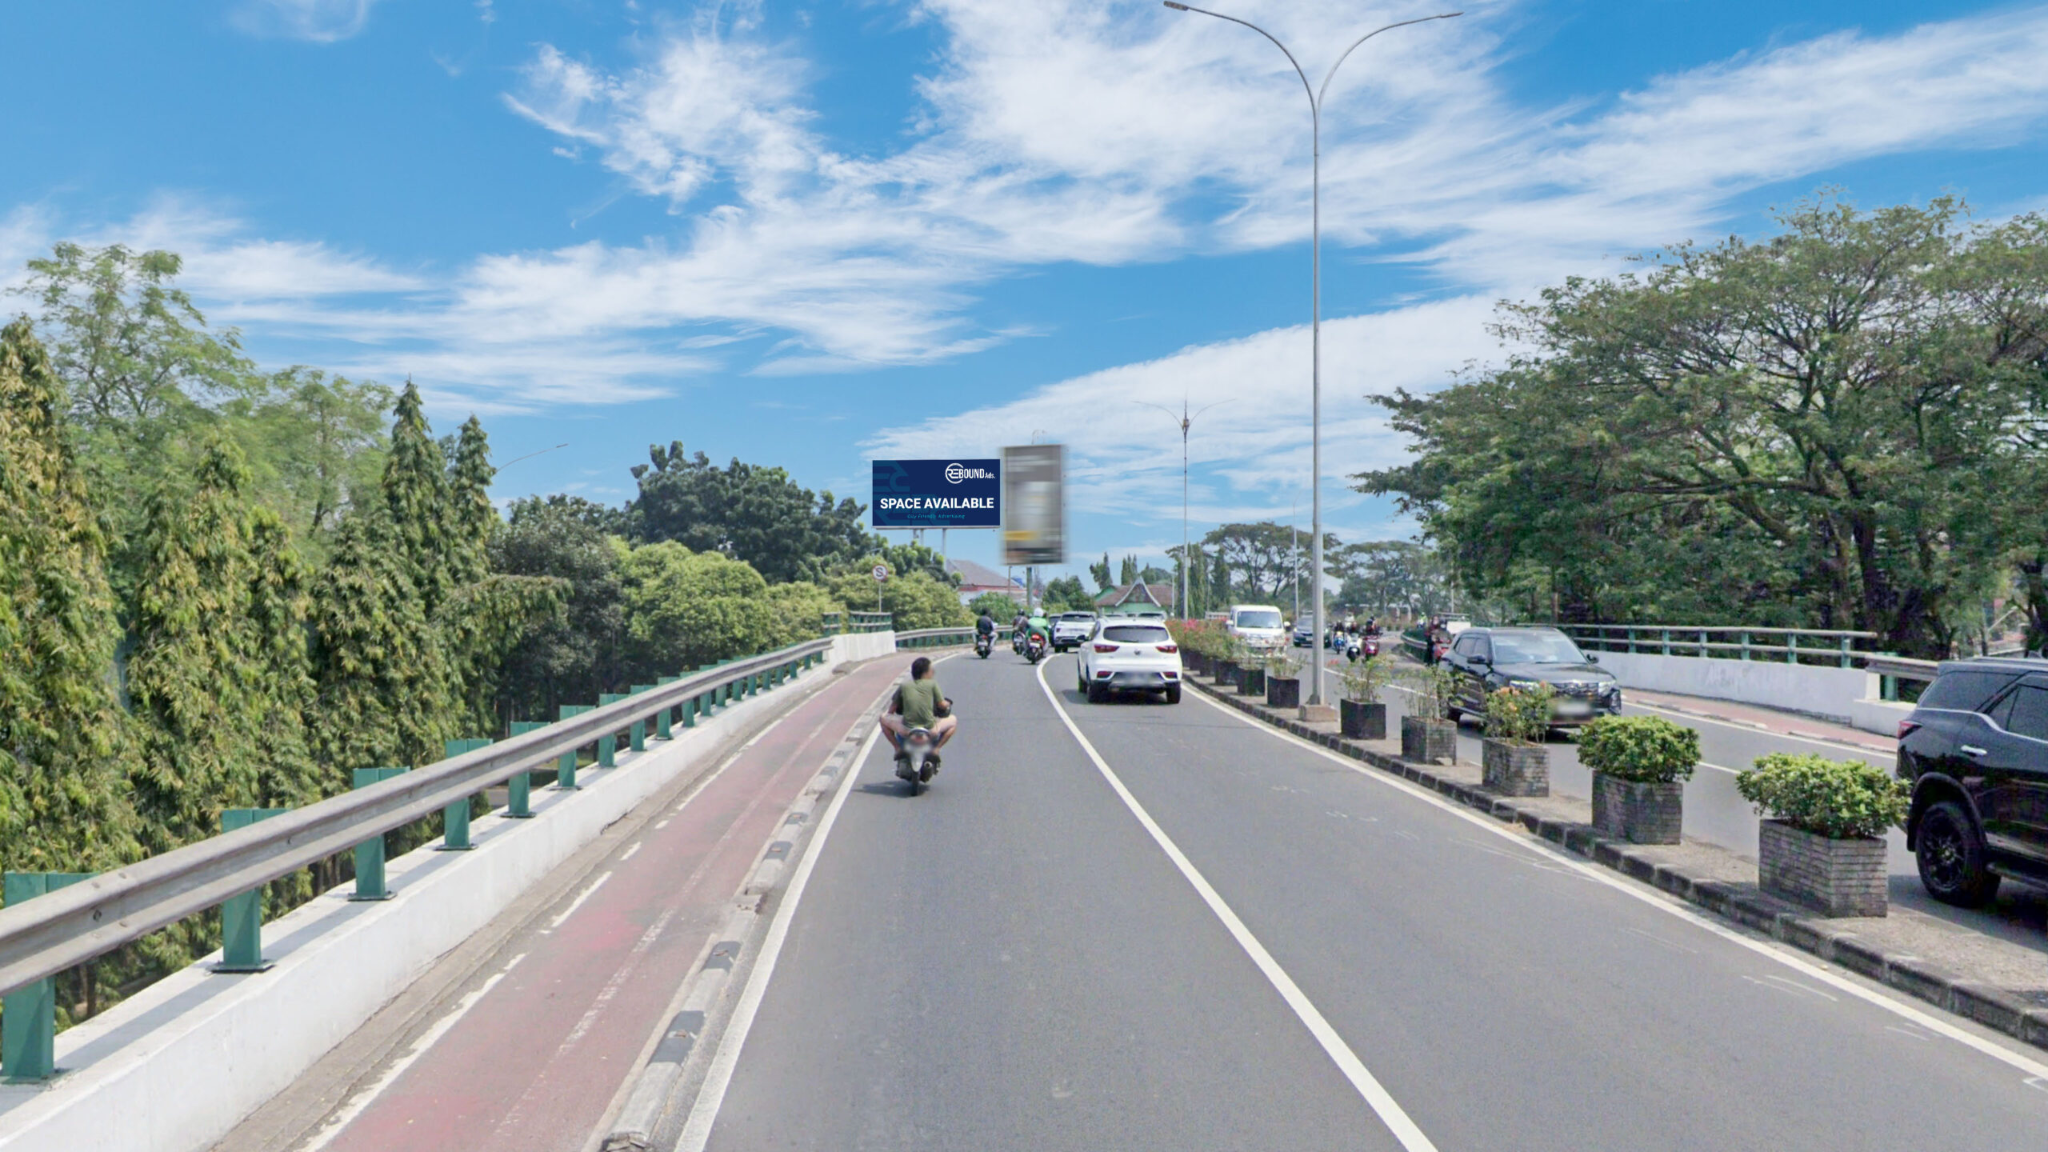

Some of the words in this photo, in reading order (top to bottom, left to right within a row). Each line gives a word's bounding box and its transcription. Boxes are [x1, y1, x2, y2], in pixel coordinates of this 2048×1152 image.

[946, 467, 985, 480] REBOUND
[880, 498, 921, 509] SPACE
[924, 498, 994, 509] AVAILABLE
